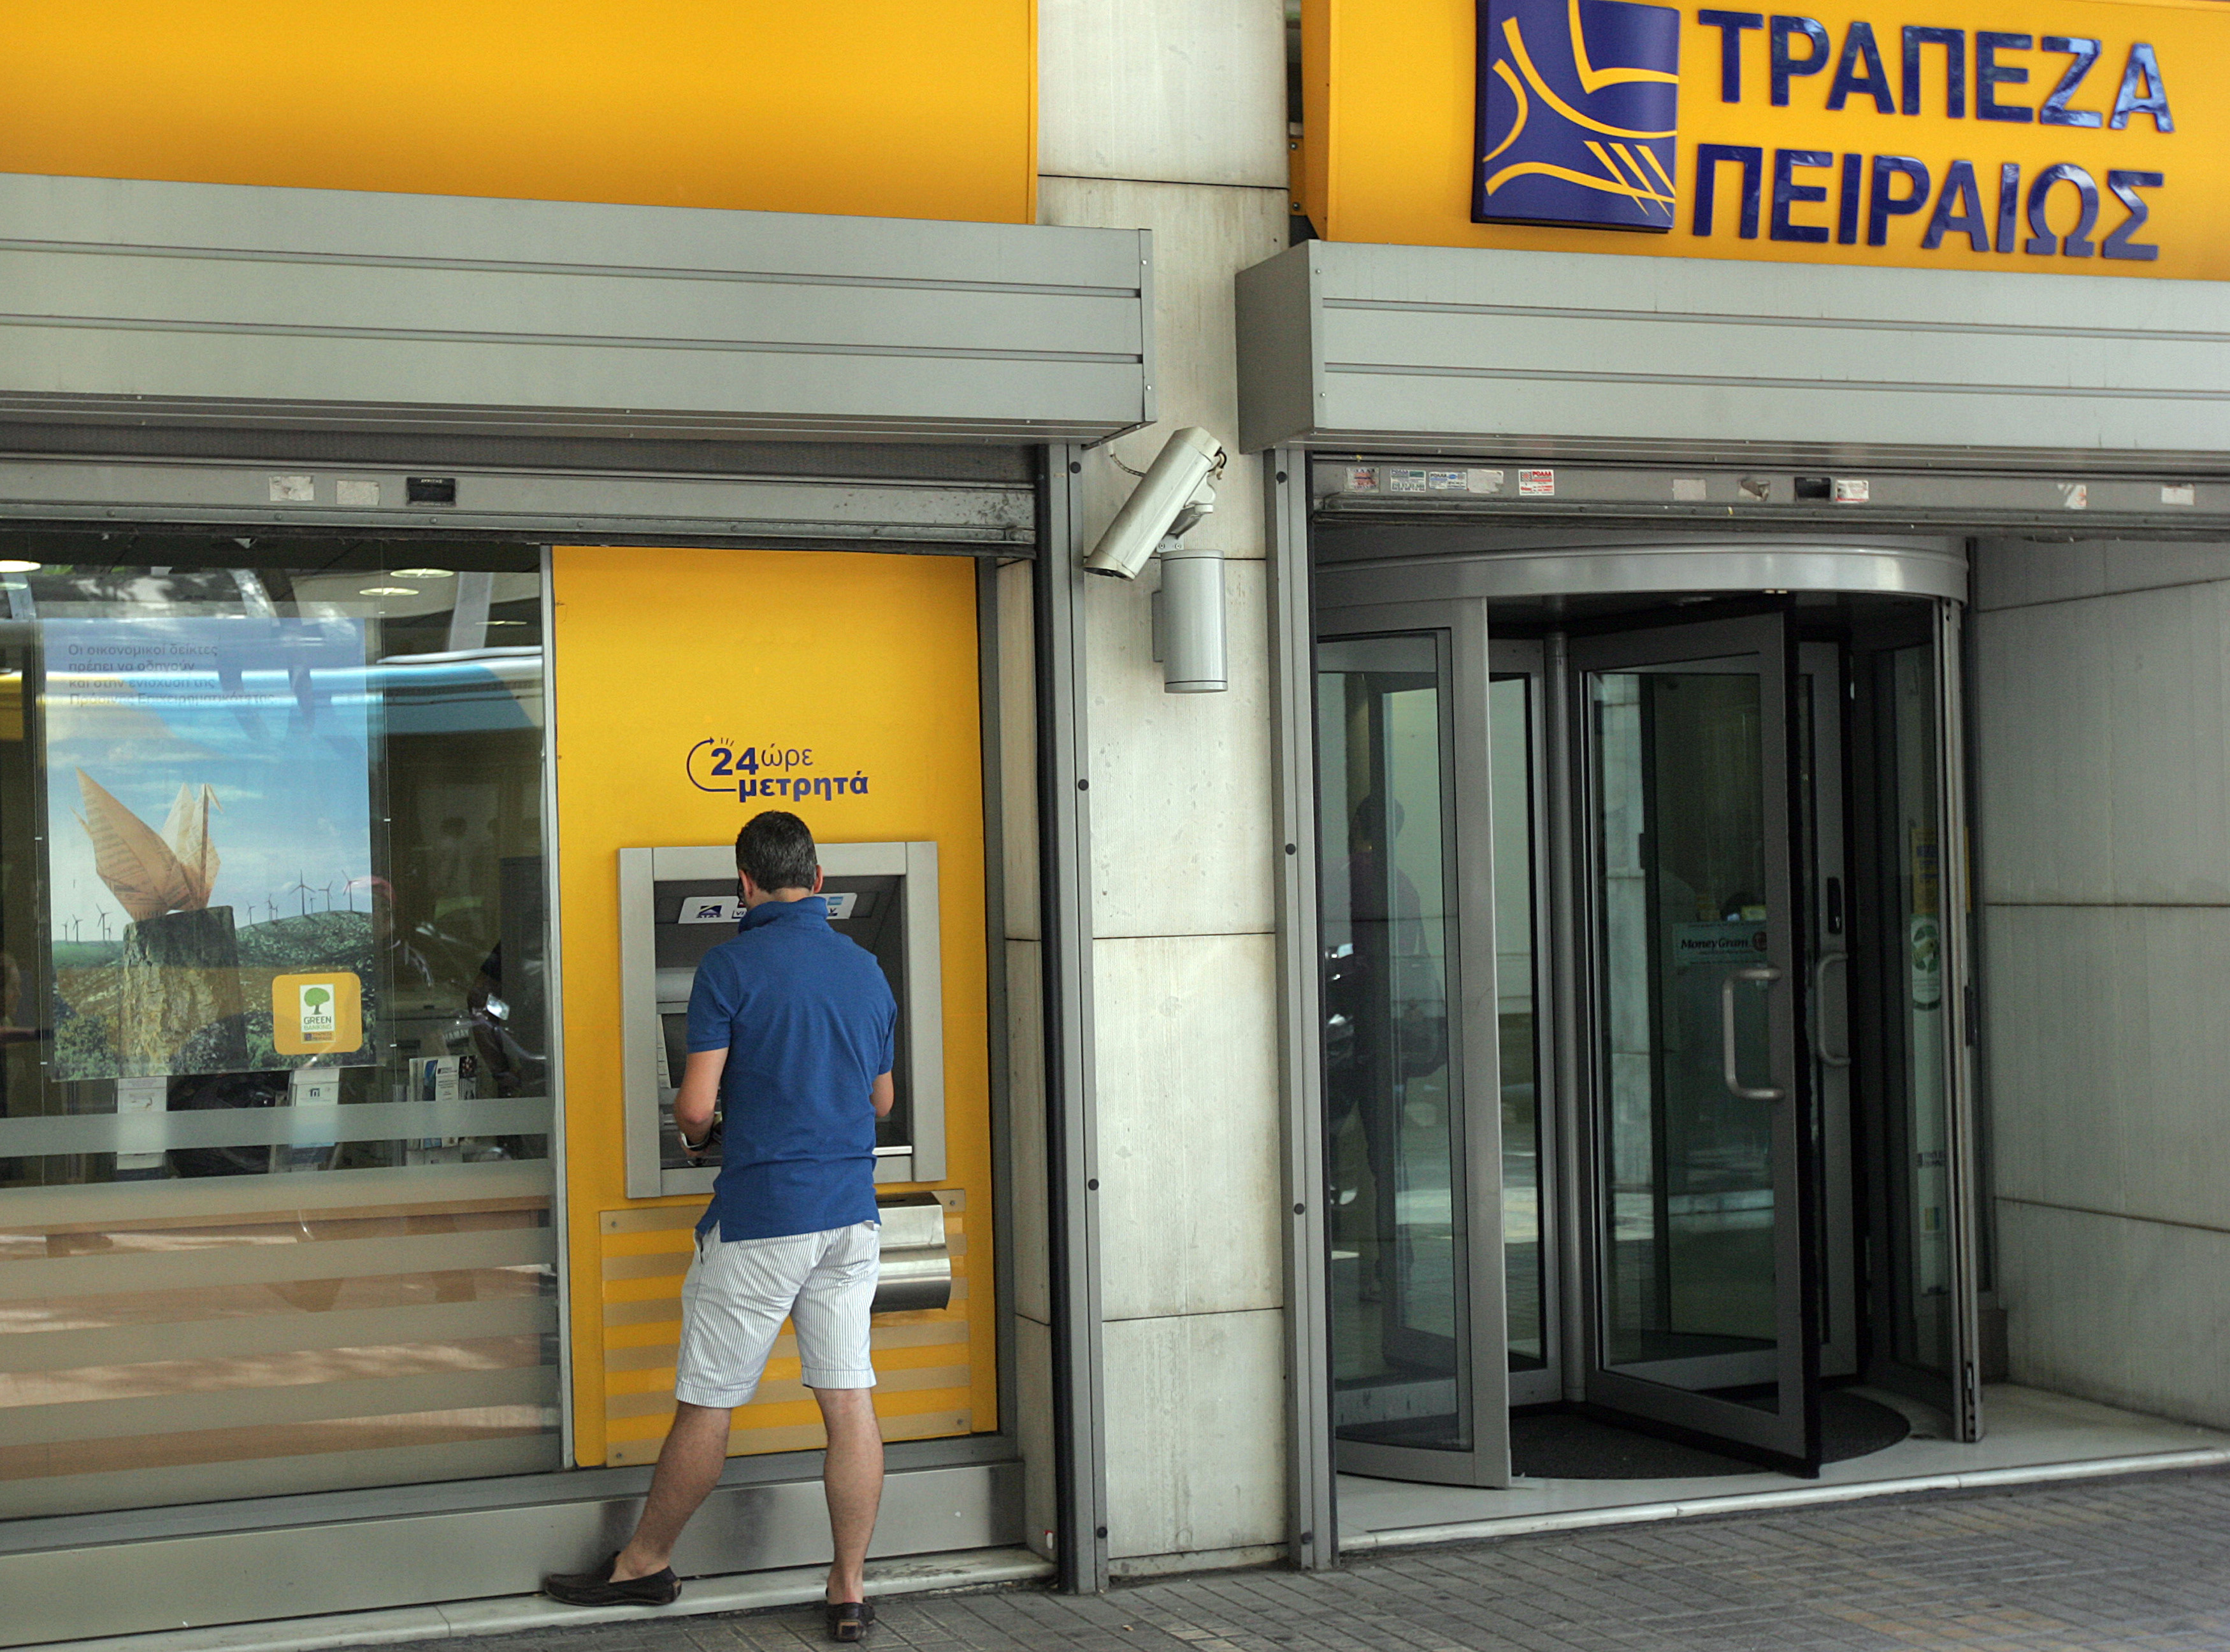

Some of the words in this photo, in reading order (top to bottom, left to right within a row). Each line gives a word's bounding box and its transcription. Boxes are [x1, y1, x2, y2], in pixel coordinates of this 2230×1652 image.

[1697, 9, 2175, 133] ΤΡΑΠΕΖΑ
[1692, 143, 2164, 261] ΠΕΙΡΑΙΩΣ
[68, 644, 82, 656] Οι
[87, 642, 165, 657] οικονομικοί
[169, 643, 218, 657] δείκτες
[68, 659, 113, 673] πρέπει
[117, 662, 134, 671] να
[739, 770, 869, 803] μετρητά
[303, 1016, 331, 1024] GREEN
